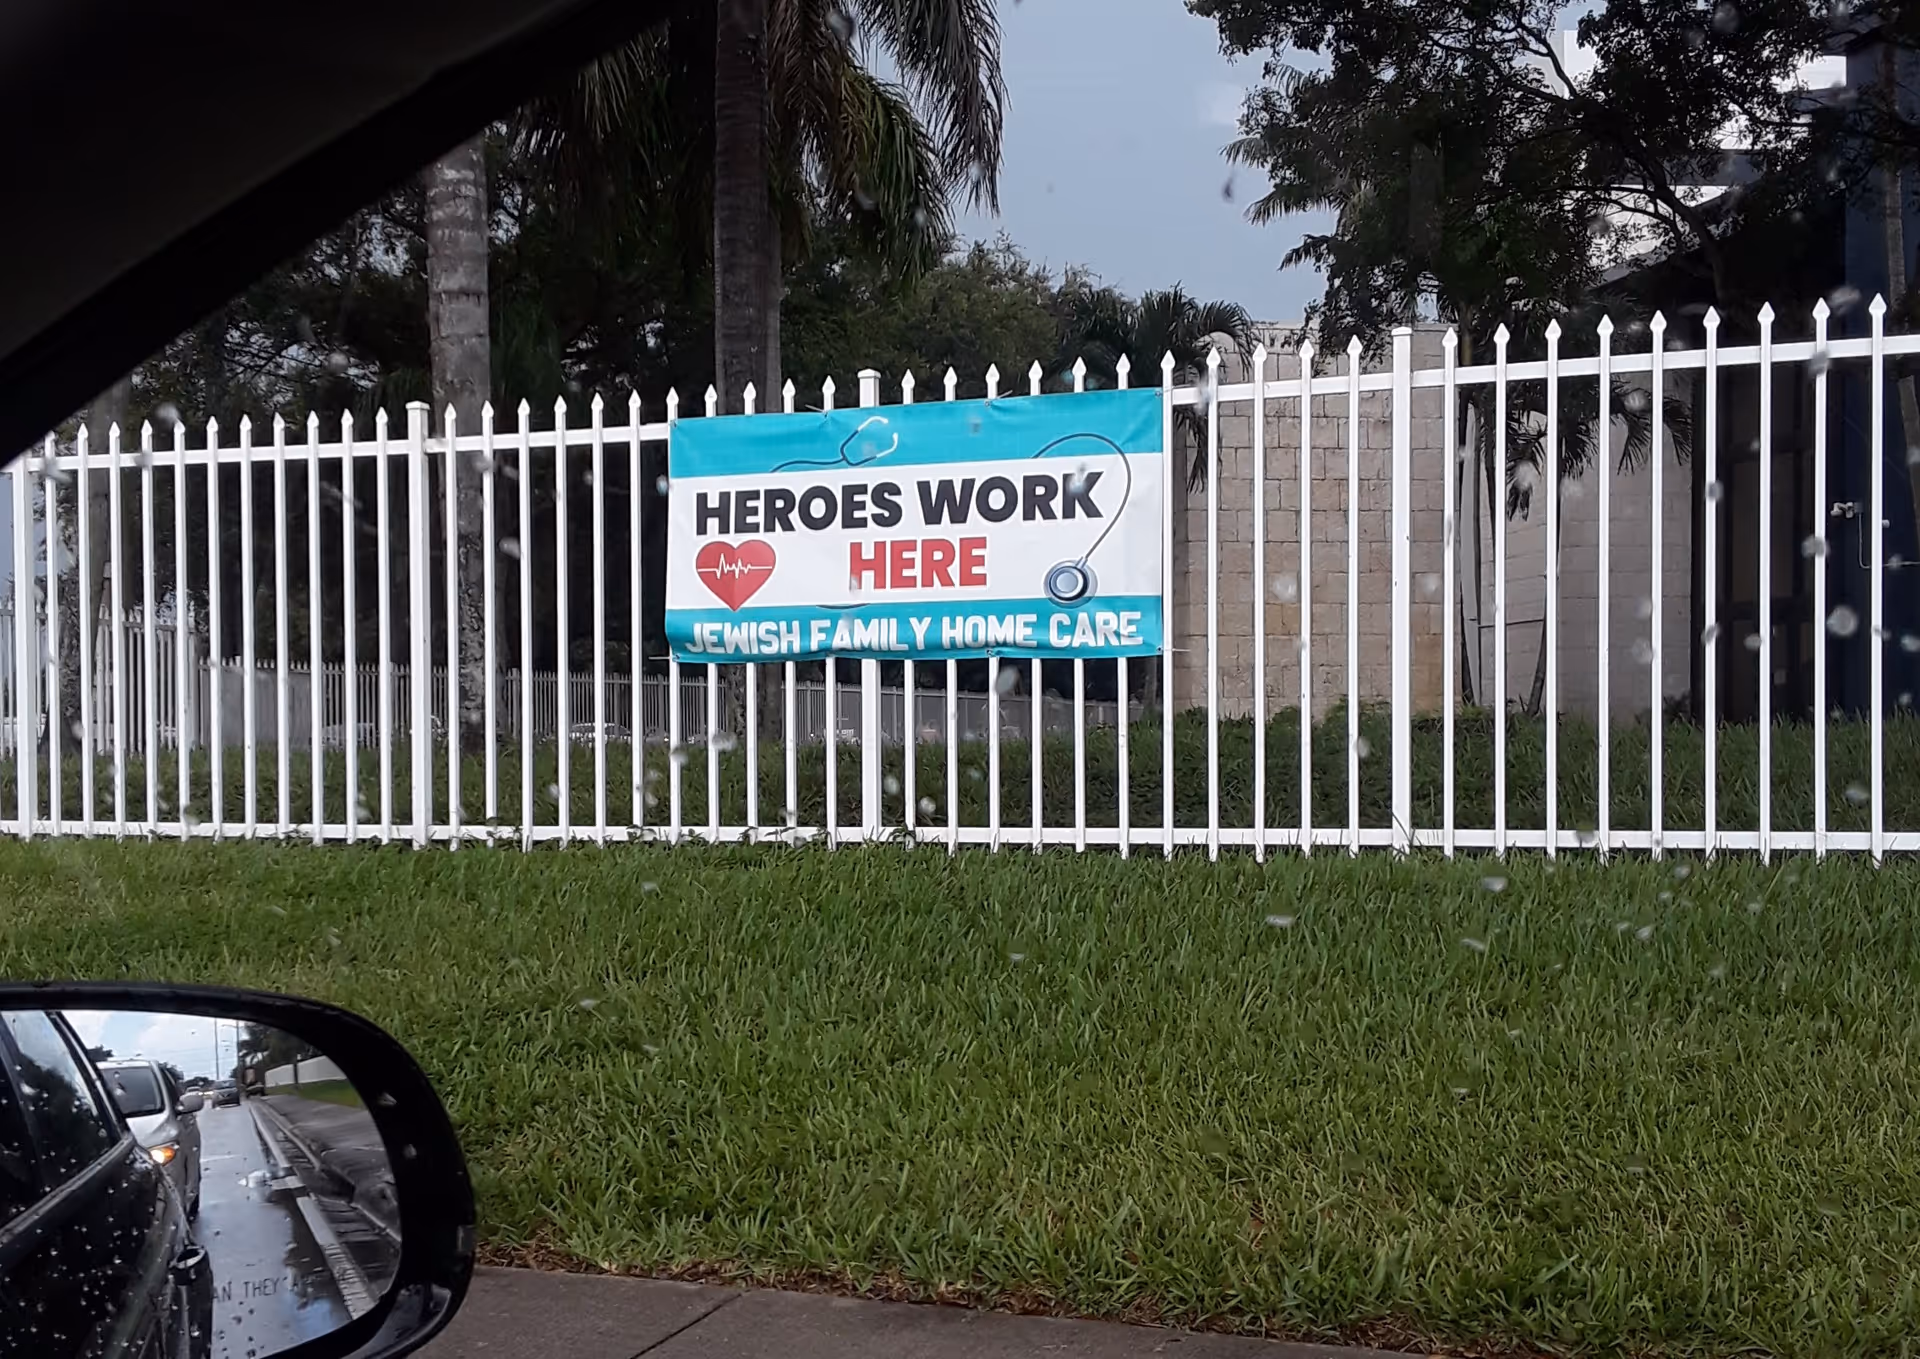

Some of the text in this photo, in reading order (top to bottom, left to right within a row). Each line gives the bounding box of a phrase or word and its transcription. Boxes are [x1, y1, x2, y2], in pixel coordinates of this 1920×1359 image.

[695, 471, 1106, 536] HEROES WORK
[849, 537, 988, 590] HERE
[685, 611, 1144, 655] JEWISH FAMILY HOME CARE
[243, 1278, 279, 1297] THEY
